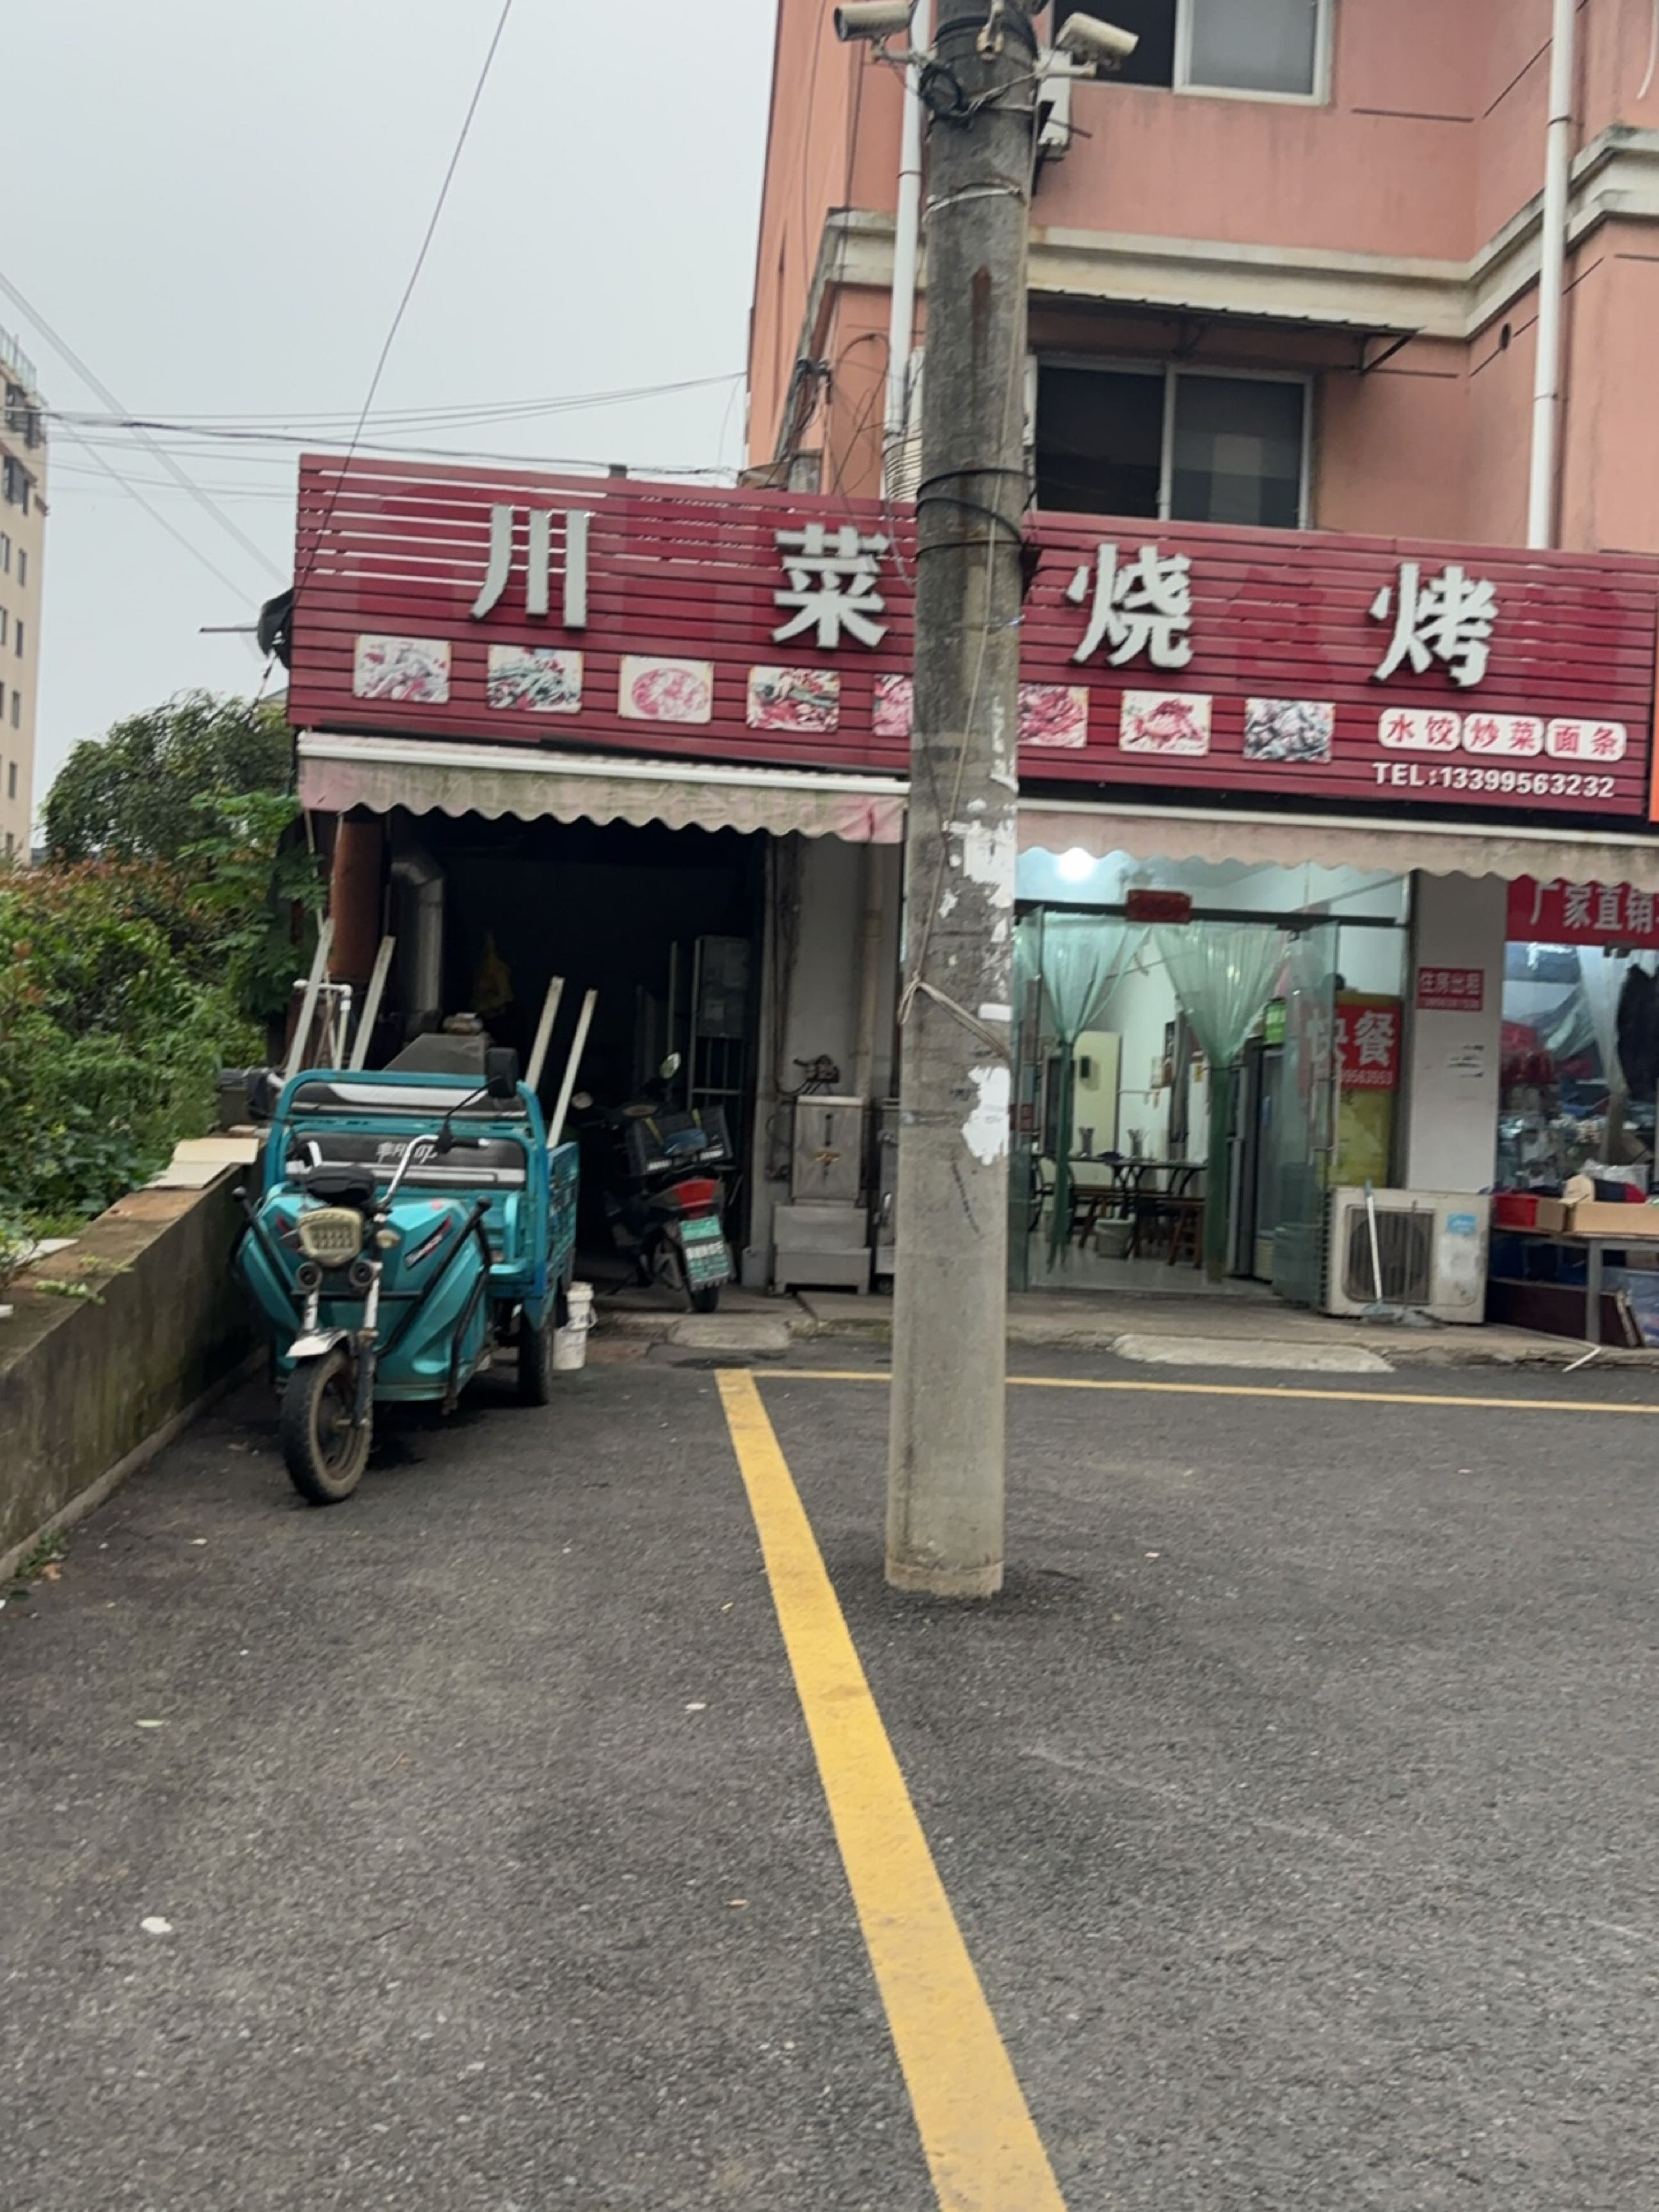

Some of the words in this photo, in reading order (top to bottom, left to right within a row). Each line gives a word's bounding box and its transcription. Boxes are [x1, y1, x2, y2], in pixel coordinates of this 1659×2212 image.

[470, 503, 1498, 688] 川菜烧烤
[1388, 713, 1454, 747] 水饺
[1471, 717, 1536, 751] 炒菜
[1554, 725, 1617, 756] 面条
[1372, 762, 1615, 798] TEL:13399563232
[1529, 883, 1659, 934] 厂家直销
[1306, 1009, 1395, 1066] 快餐
